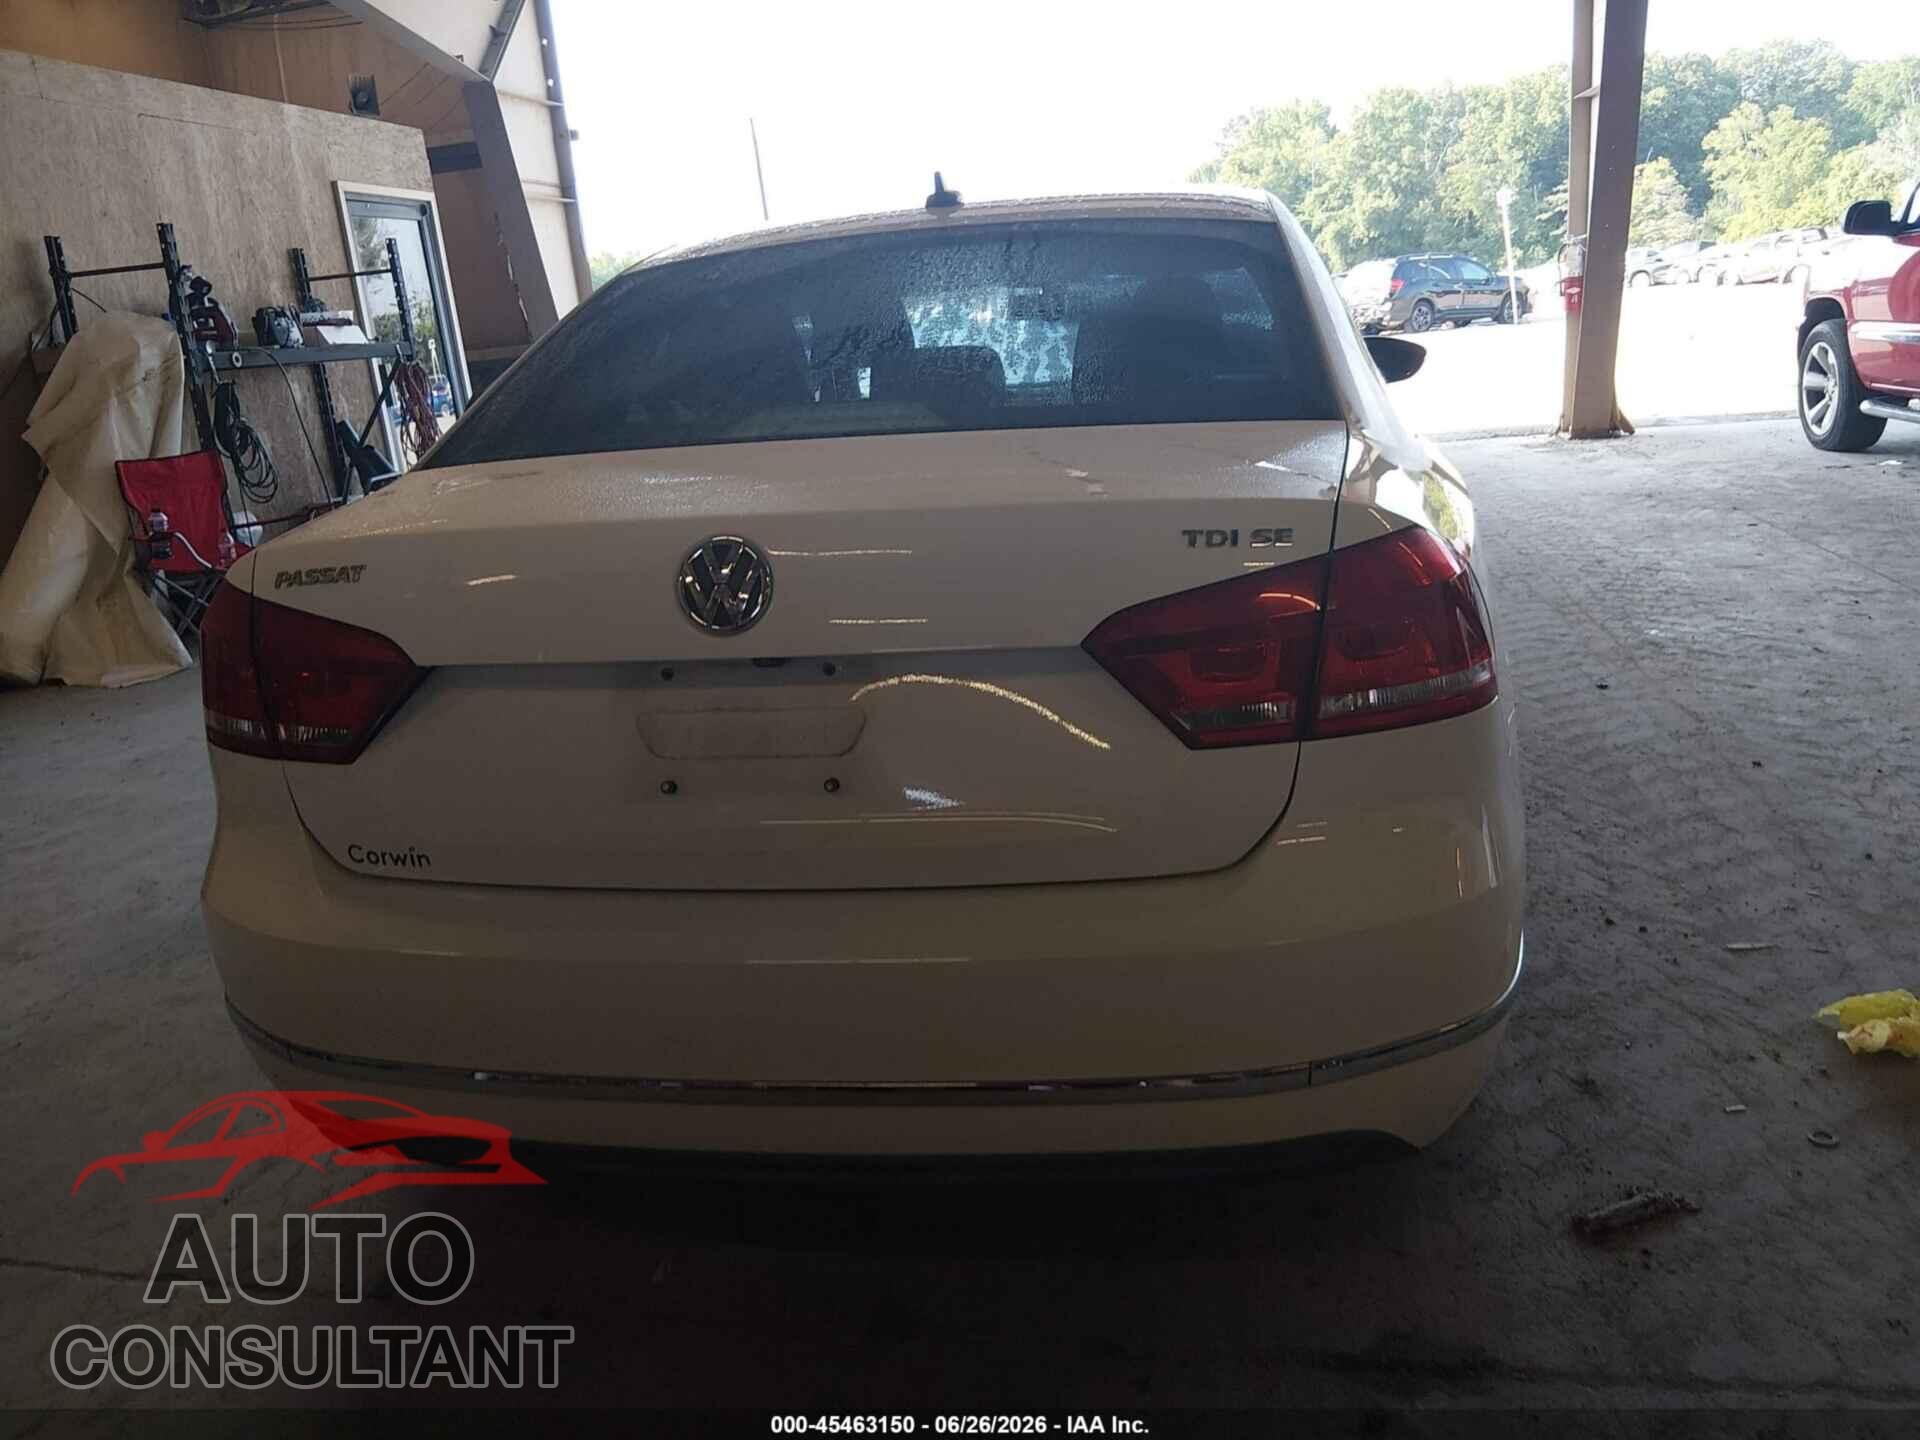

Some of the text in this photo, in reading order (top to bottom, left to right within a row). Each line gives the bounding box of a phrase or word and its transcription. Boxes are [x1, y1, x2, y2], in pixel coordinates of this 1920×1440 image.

[1181, 528, 1294, 548] TDI SE
[274, 564, 367, 589] PASSAT
[679, 536, 772, 633] VW
[348, 844, 431, 867] Corwin
